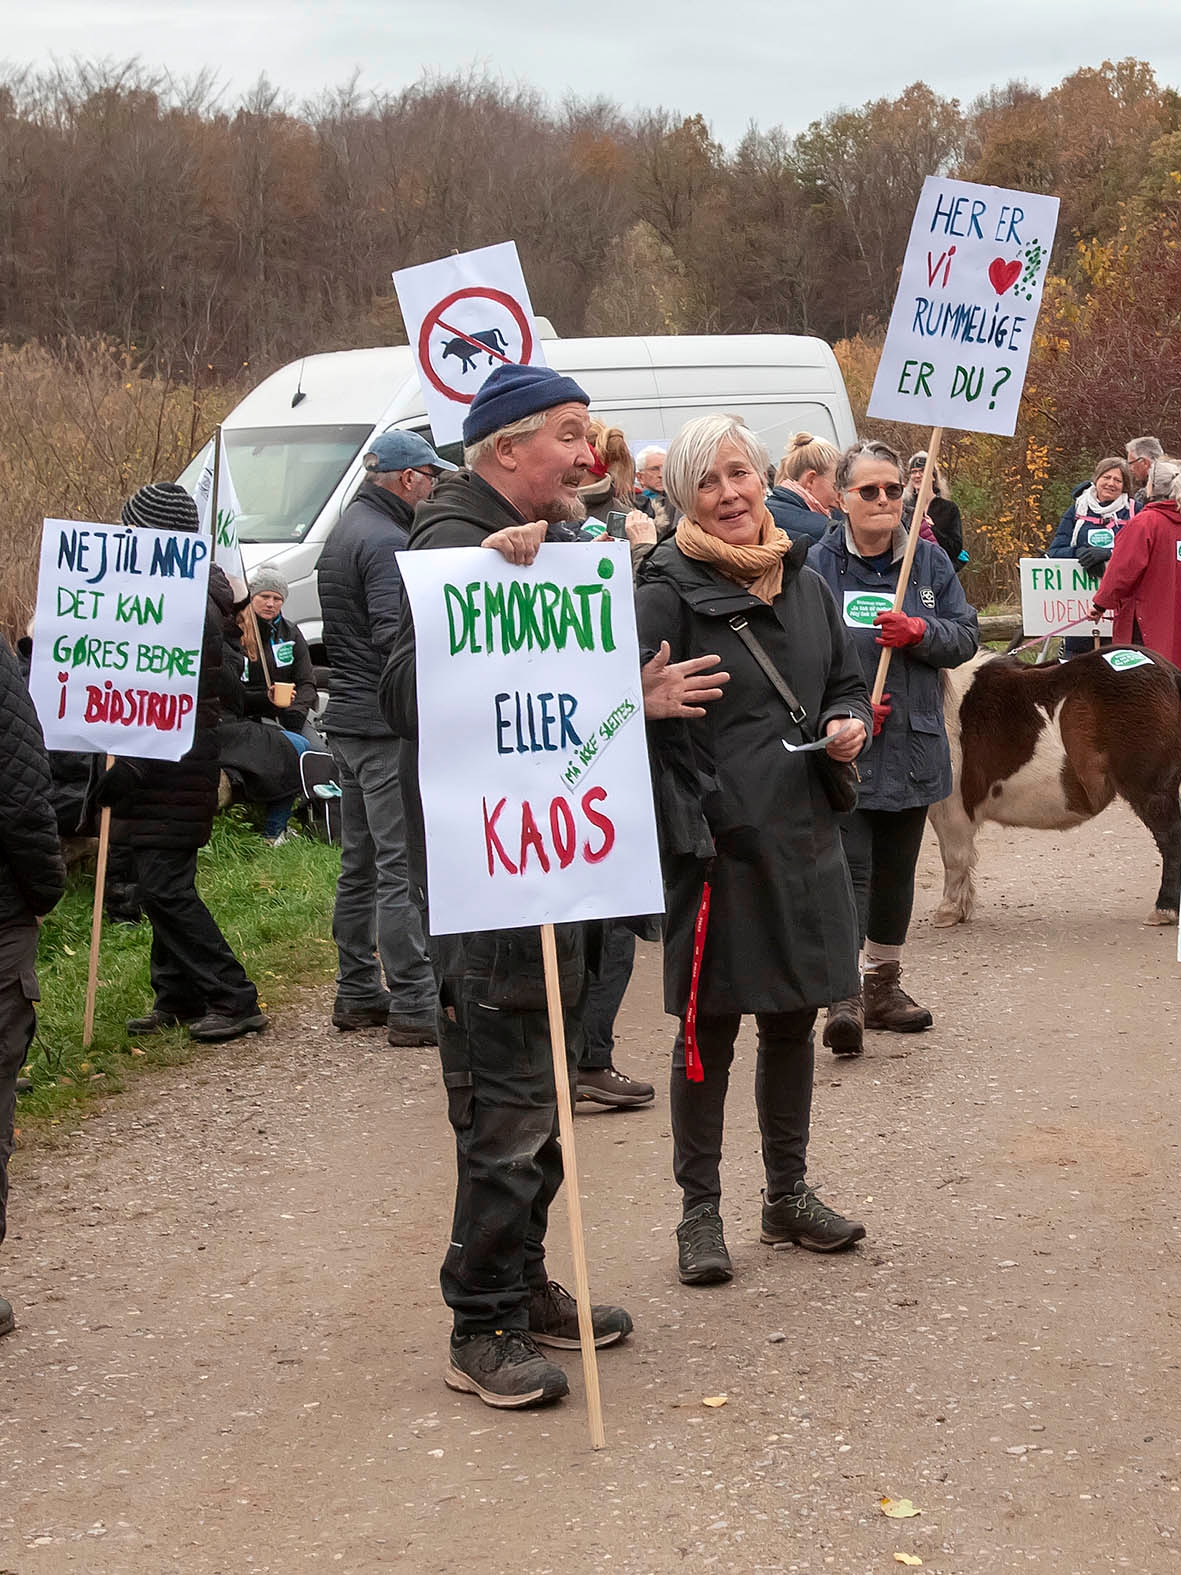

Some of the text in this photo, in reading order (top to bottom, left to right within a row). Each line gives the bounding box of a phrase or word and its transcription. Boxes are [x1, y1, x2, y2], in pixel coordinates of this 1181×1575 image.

[930, 193, 1025, 246] HER ER
[897, 360, 1012, 411] ER DU?
[57, 528, 108, 585] NEJ
[56, 585, 165, 626] DET KAN
[1043, 598, 1090, 624] UDEN
[53, 633, 200, 681] GØRES BEDRE
[494, 691, 583, 755] ELLER
[482, 785, 617, 878] KAOS
